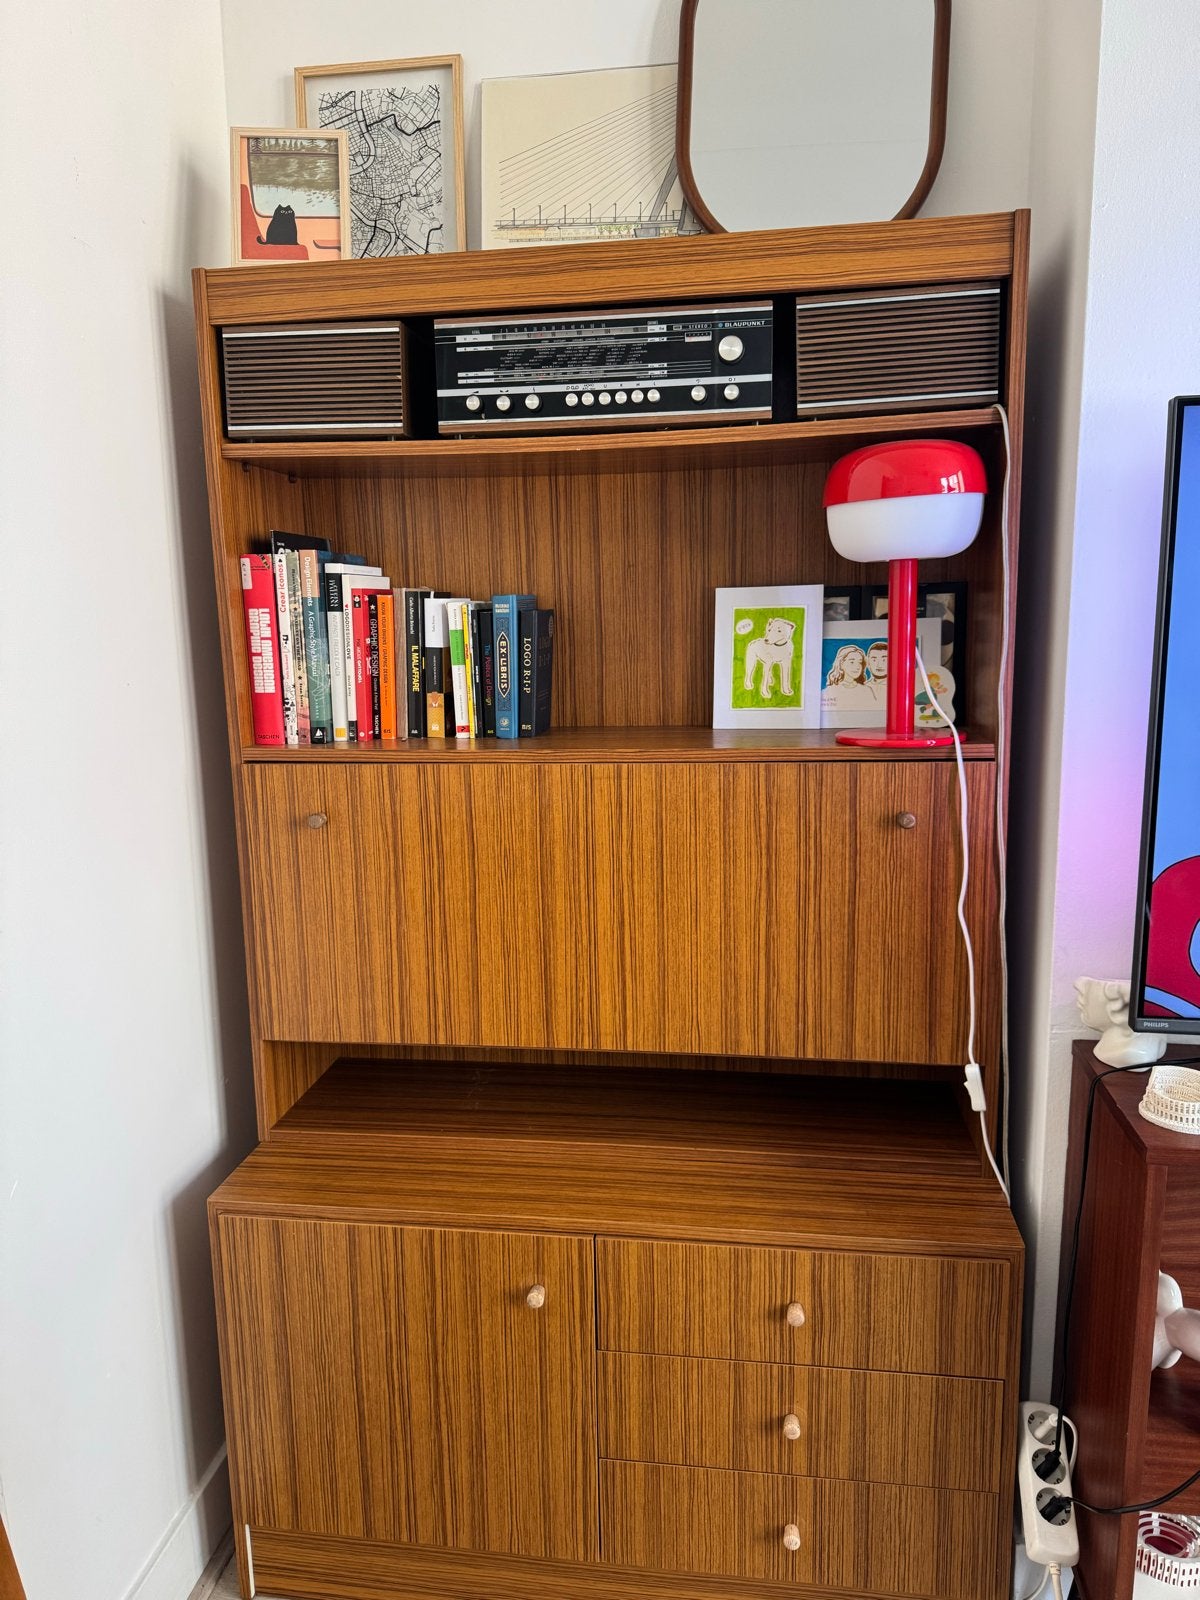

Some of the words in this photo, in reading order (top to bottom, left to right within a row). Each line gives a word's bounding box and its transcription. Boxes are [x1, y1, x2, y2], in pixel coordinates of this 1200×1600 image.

[724, 320, 765, 328] BLAUPUNKT
[277, 564, 285, 590] iconos
[303, 556, 312, 578] Design
[278, 591, 287, 613] Crear
[306, 578, 314, 606] Elements
[248, 608, 262, 653] GRAPHIC
[308, 616, 316, 640] Graphic
[370, 619, 378, 650] GRAPHIC
[523, 637, 532, 667] LOGO
[252, 656, 265, 694] DESIGN
[262, 640, 276, 694] AMERICAN
[412, 652, 420, 692] MALAFFARE
[485, 685, 493, 706] Design
